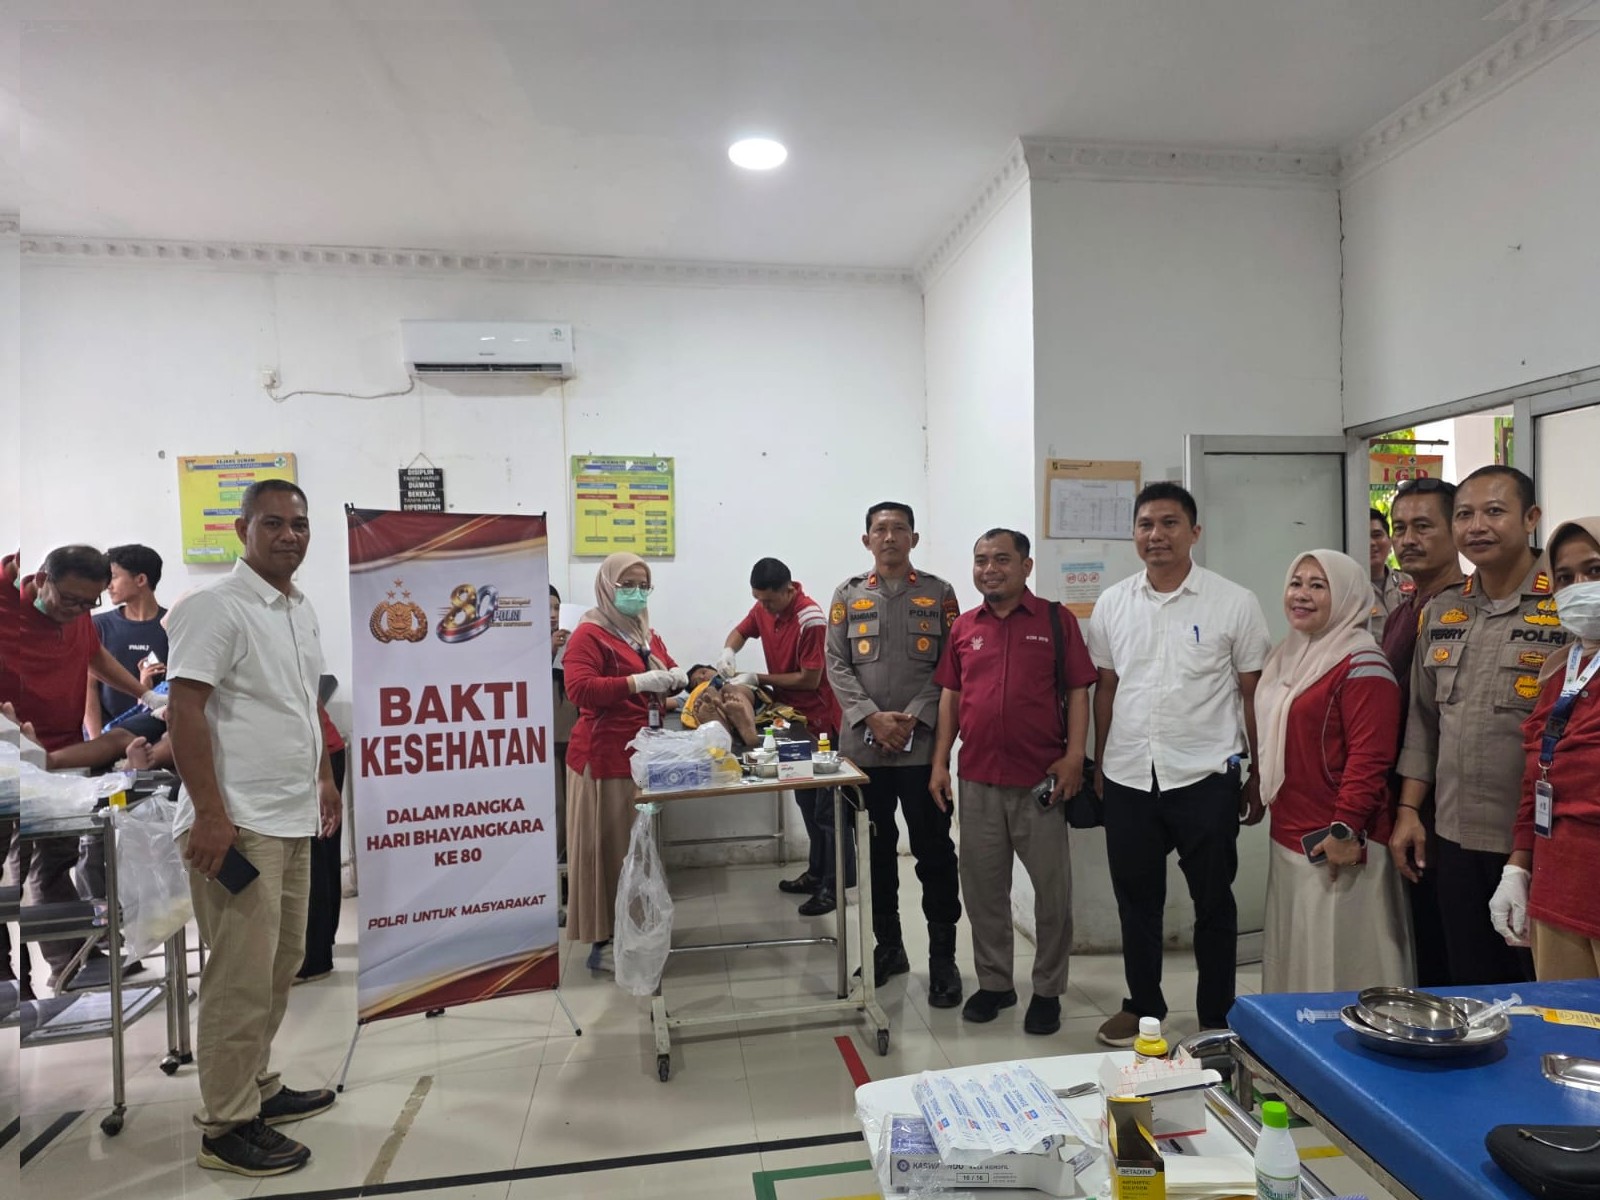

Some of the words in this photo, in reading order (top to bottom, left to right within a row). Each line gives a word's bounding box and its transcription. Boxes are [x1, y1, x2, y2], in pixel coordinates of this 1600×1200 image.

[1383, 467, 1430, 482] IGD
[407, 490, 436, 498] BEKERJA
[909, 609, 939, 618] POLRI
[1510, 629, 1568, 645] POLRI
[379, 681, 528, 727] BAKTI
[361, 726, 547, 778] KESEHATAN
[386, 804, 450, 825] DALAM
[453, 798, 525, 819] RANGKA
[366, 829, 410, 852] HARI
[414, 818, 544, 846] BHAYANGKARA
[434, 850, 458, 867] KE
[461, 848, 482, 864] 80
[368, 914, 408, 931] POLRI
[413, 906, 457, 923] UNTUK
[461, 895, 547, 917] MASYARAKAT
